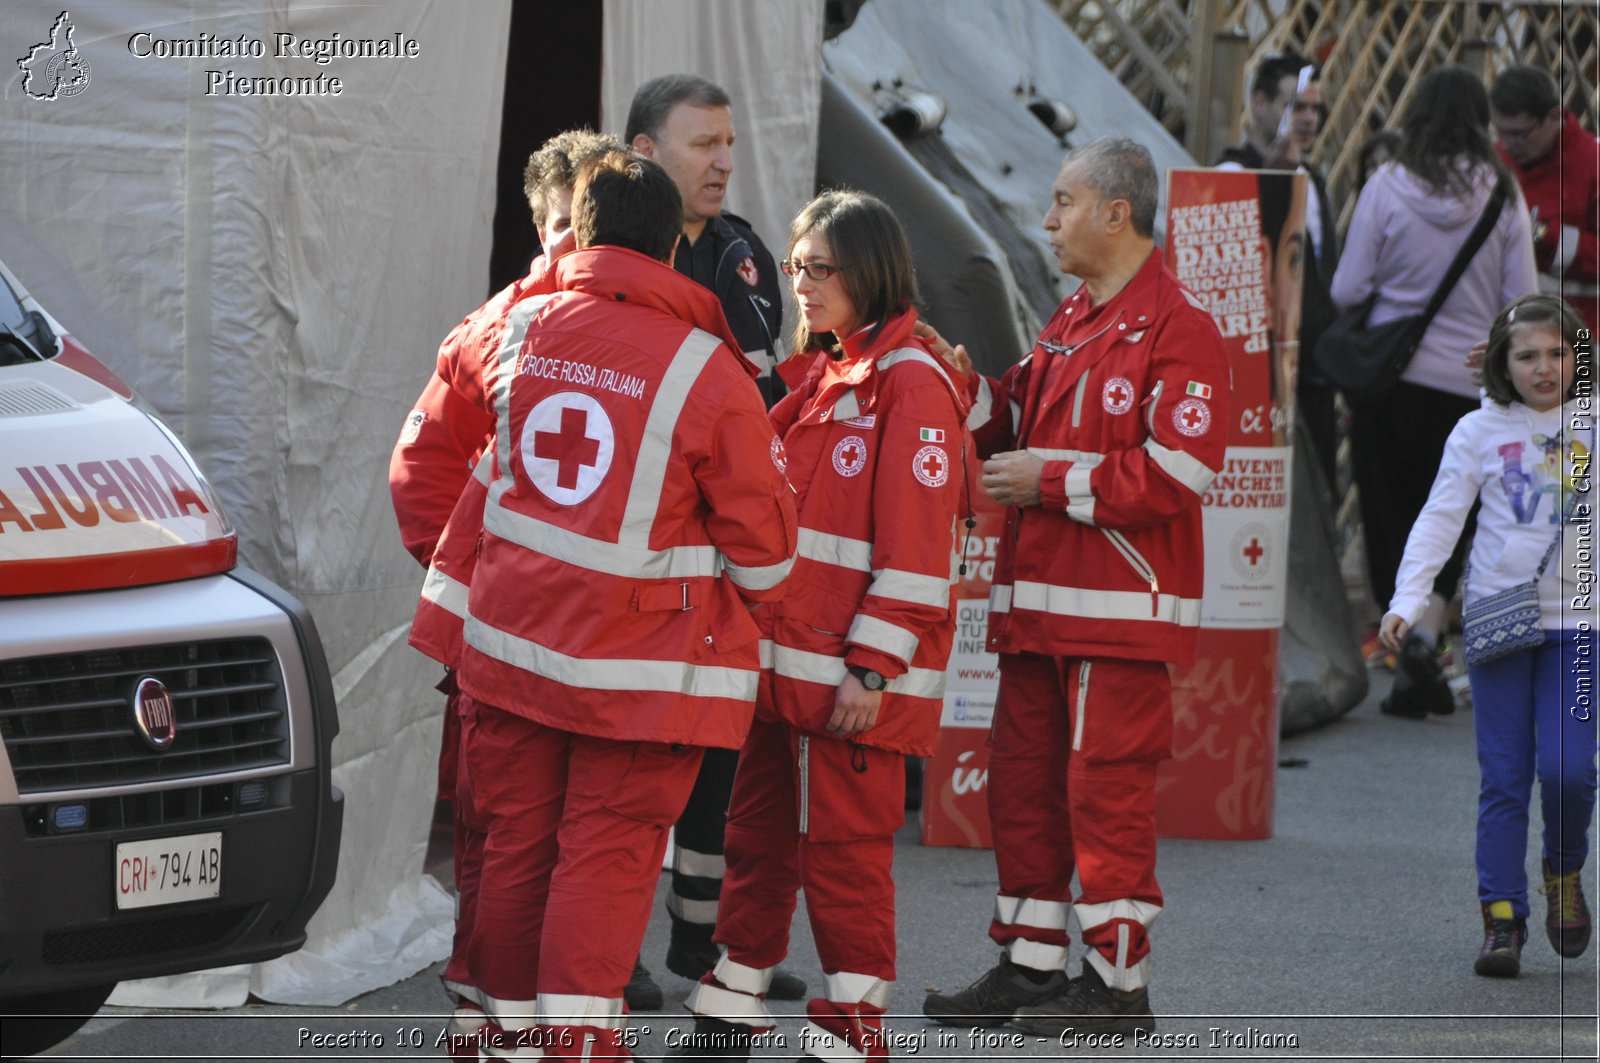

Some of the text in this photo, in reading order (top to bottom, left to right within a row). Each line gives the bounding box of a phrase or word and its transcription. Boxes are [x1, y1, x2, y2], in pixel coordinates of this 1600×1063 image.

[1172, 209, 1260, 237] AMARE
[1173, 226, 1261, 248] CREDERE
[1175, 239, 1262, 268] DARE
[1244, 331, 1269, 353] di
[519, 354, 646, 400] CROCE ROSSA ITALIANA
[143, 697, 169, 729] FIAT
[120, 847, 219, 894] CRI 794 AB
